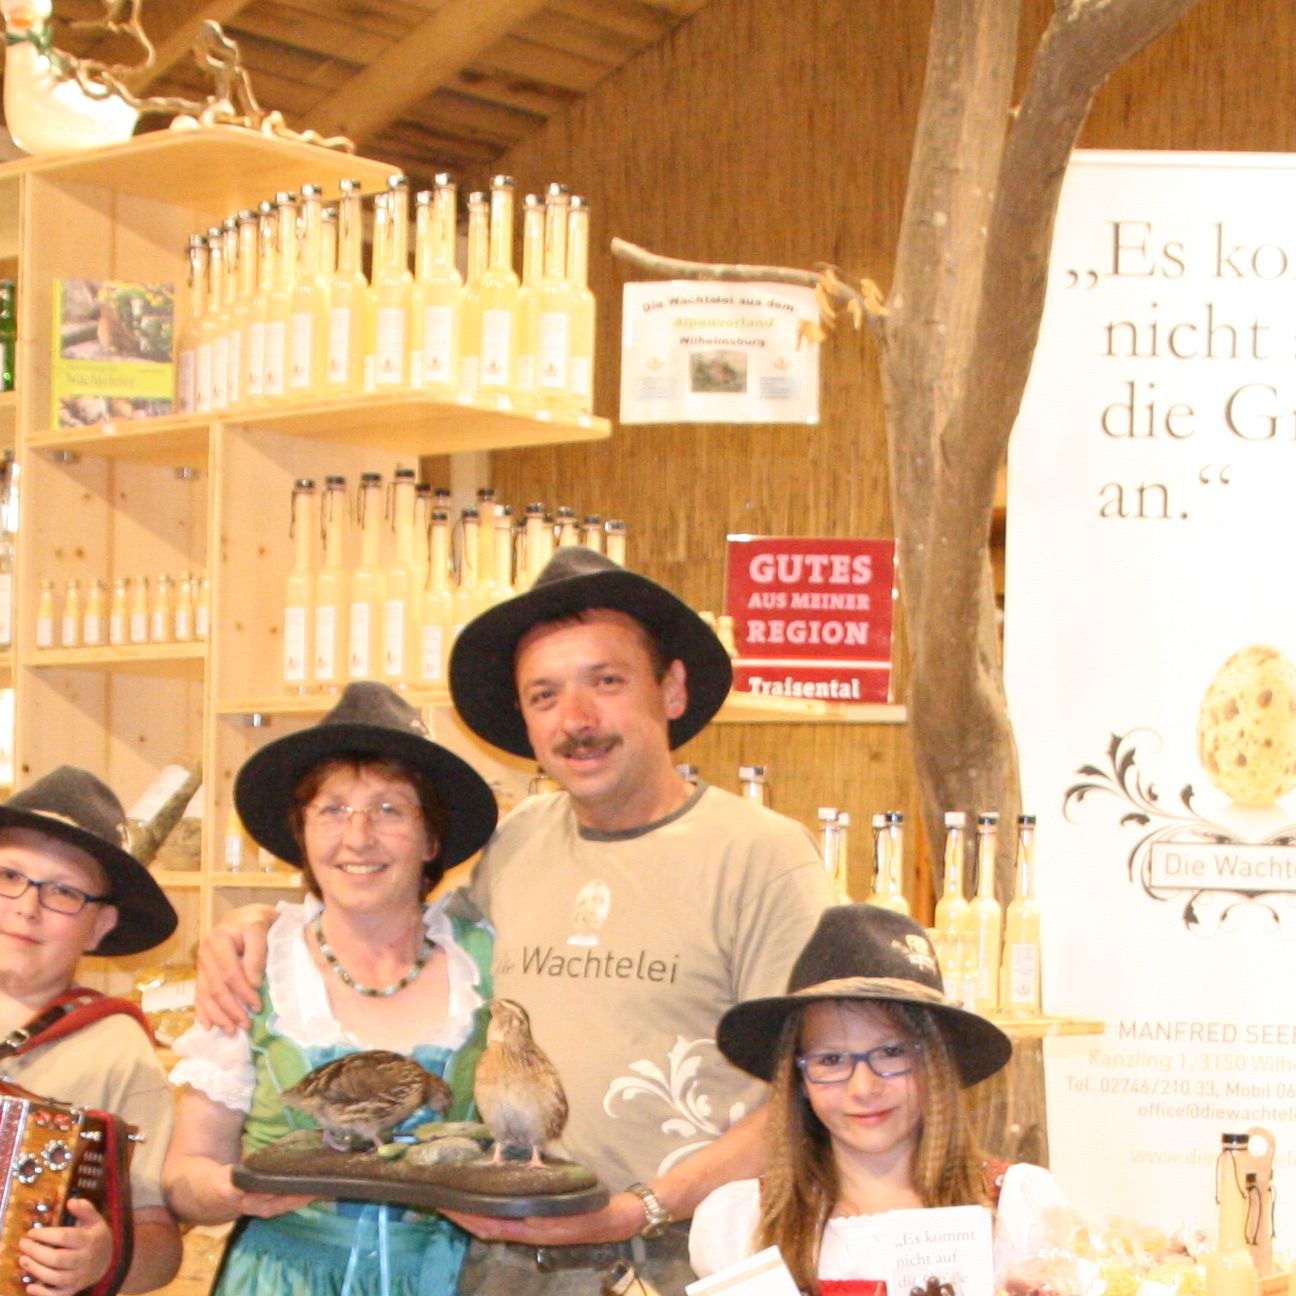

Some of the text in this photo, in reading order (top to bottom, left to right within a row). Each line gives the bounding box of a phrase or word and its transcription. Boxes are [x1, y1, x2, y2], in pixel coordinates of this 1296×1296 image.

[1064, 220, 1187, 290] „Es
[1101, 302, 1271, 361] nicht
[1100, 380, 1195, 440] die
[1098, 463, 1232, 521] an.“
[748, 553, 872, 585] GUTES
[748, 591, 871, 611] AUS MEINER
[746, 619, 869, 645] REGION
[749, 677, 859, 697] Traisental
[1164, 852, 1204, 876] Die
[521, 945, 680, 985] Wachtelei
[1118, 1021, 1237, 1044] MANFRED
[1088, 1050, 1171, 1074] Kanzling
[1199, 1053, 1246, 1073] 3150
[1225, 1080, 1271, 1099] Mobil
[925, 1230, 976, 1244] kommt
[896, 1249, 959, 1268] nicht auf
